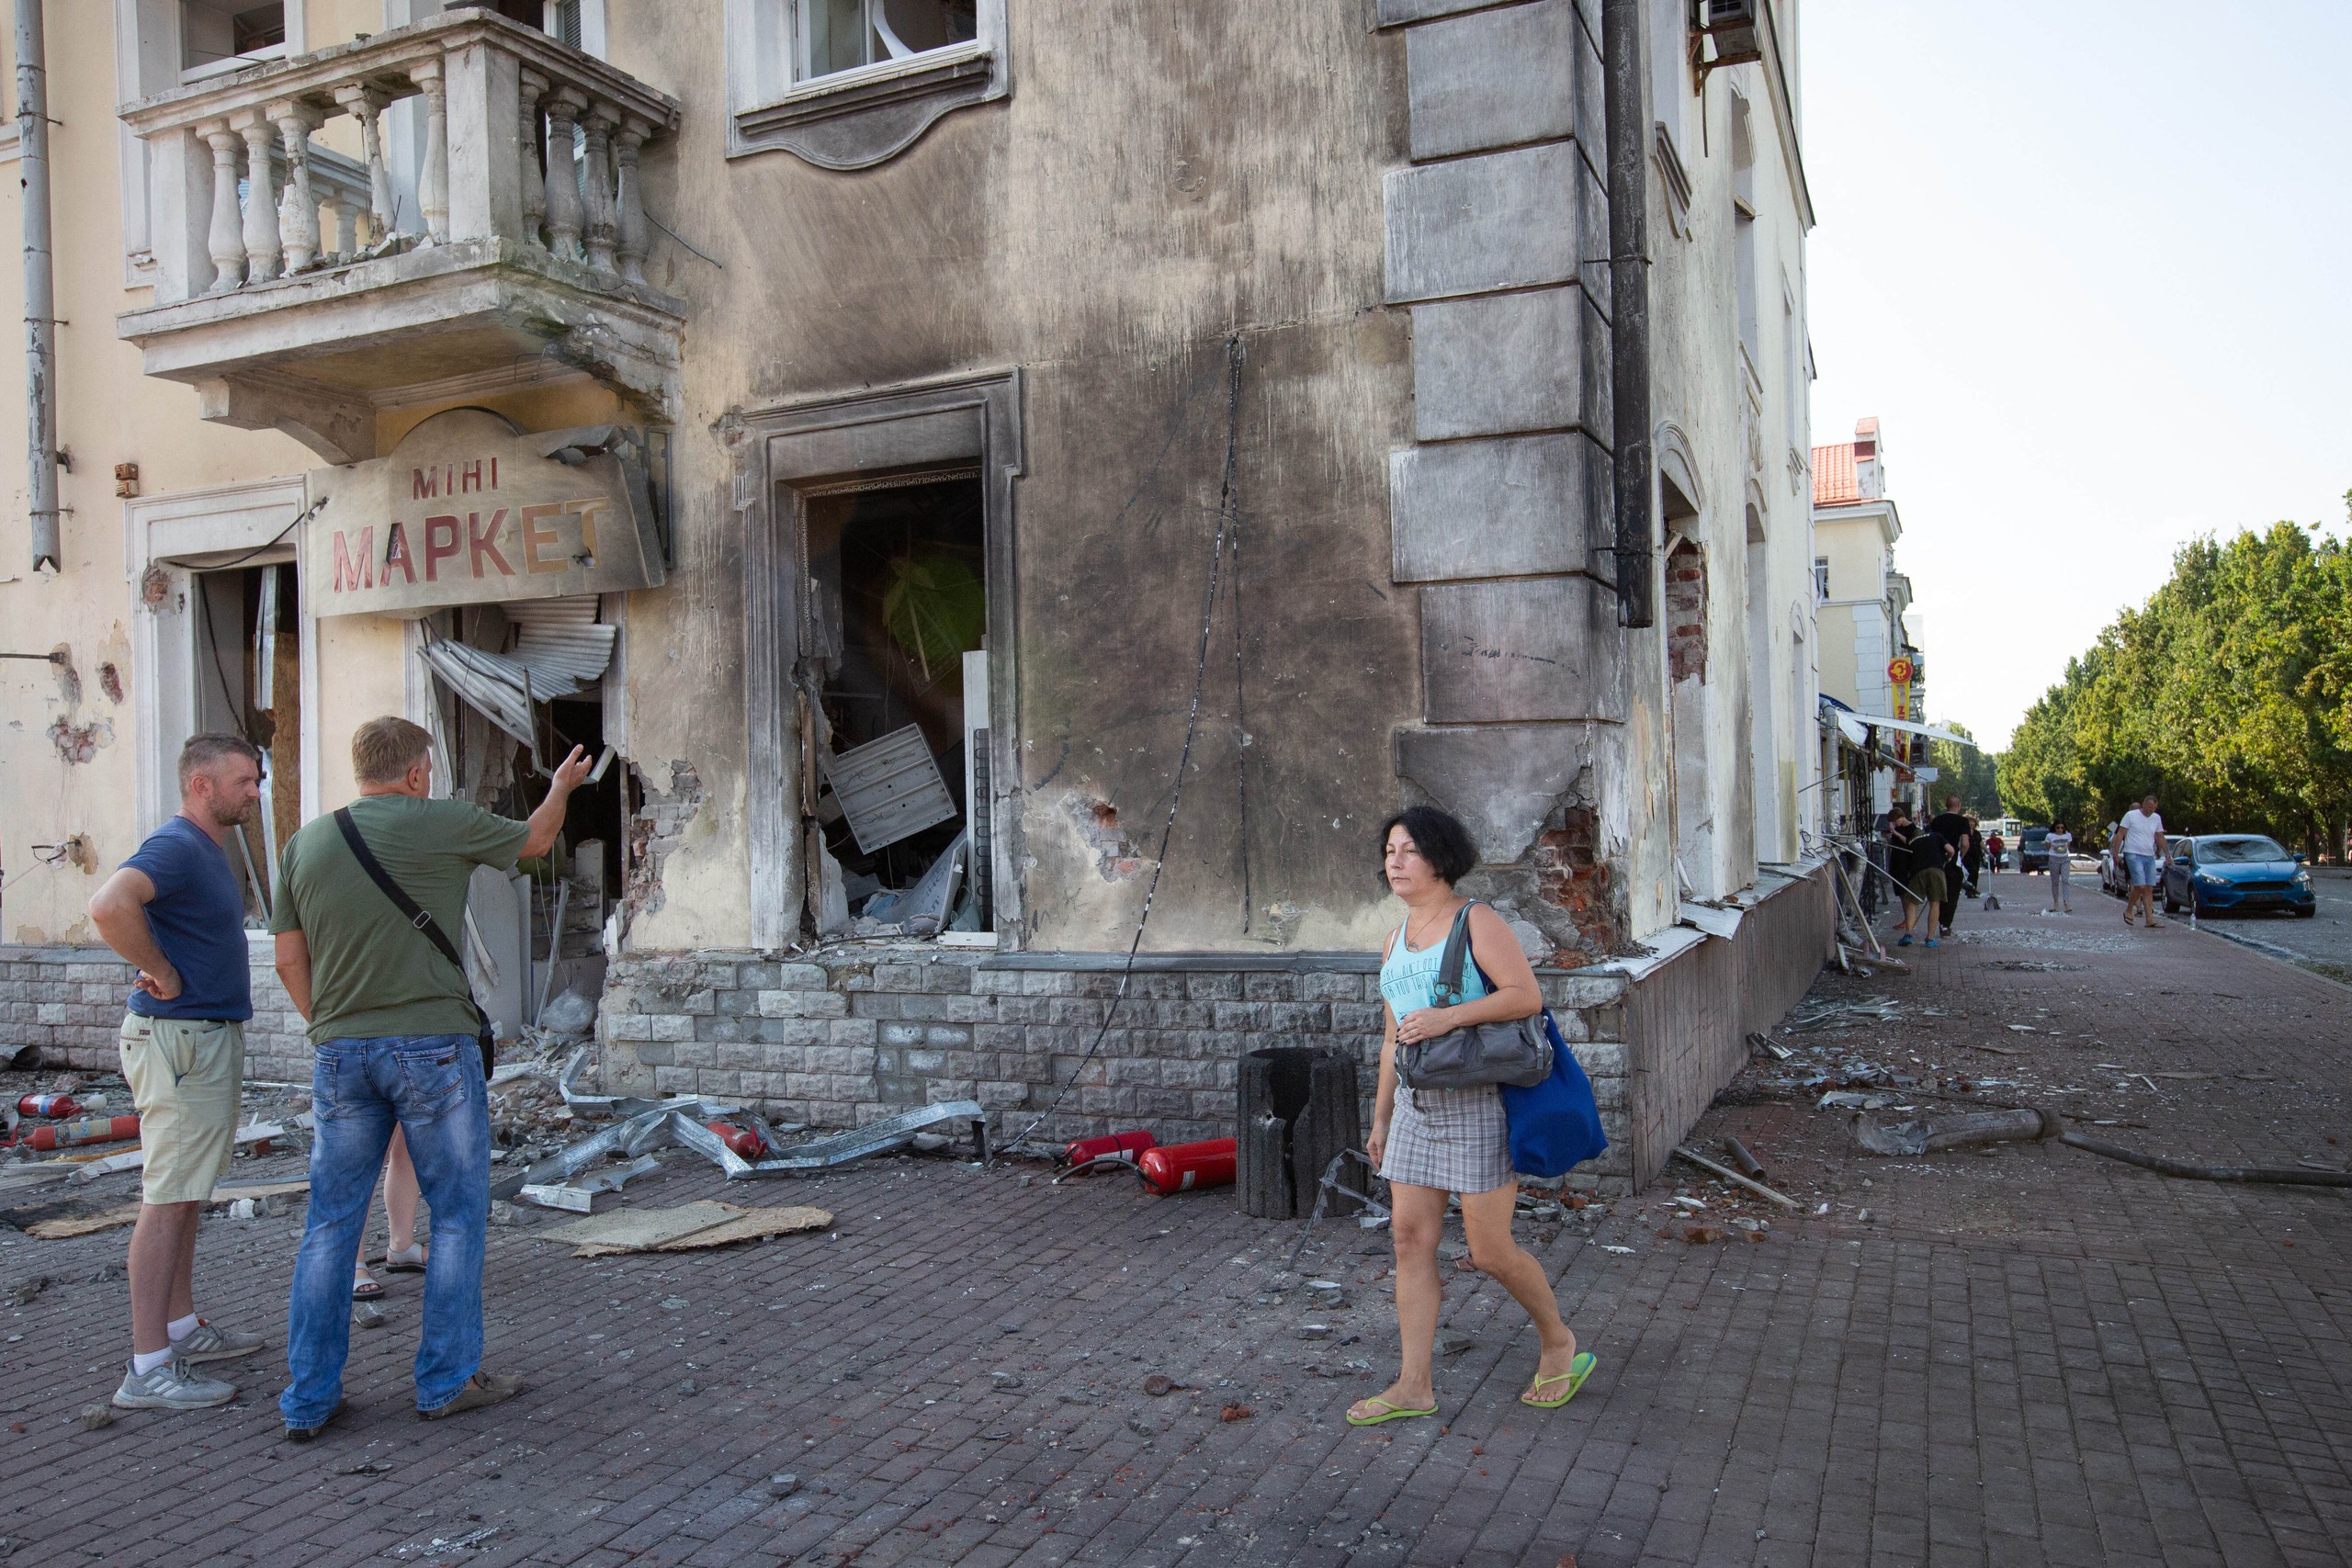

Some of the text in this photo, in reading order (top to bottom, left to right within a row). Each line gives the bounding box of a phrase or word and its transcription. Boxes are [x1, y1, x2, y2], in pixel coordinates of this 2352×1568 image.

[413, 457, 498, 501] МІНІ
[334, 497, 609, 593] МАРКЕТ
[1395, 980, 1410, 996] YOU
